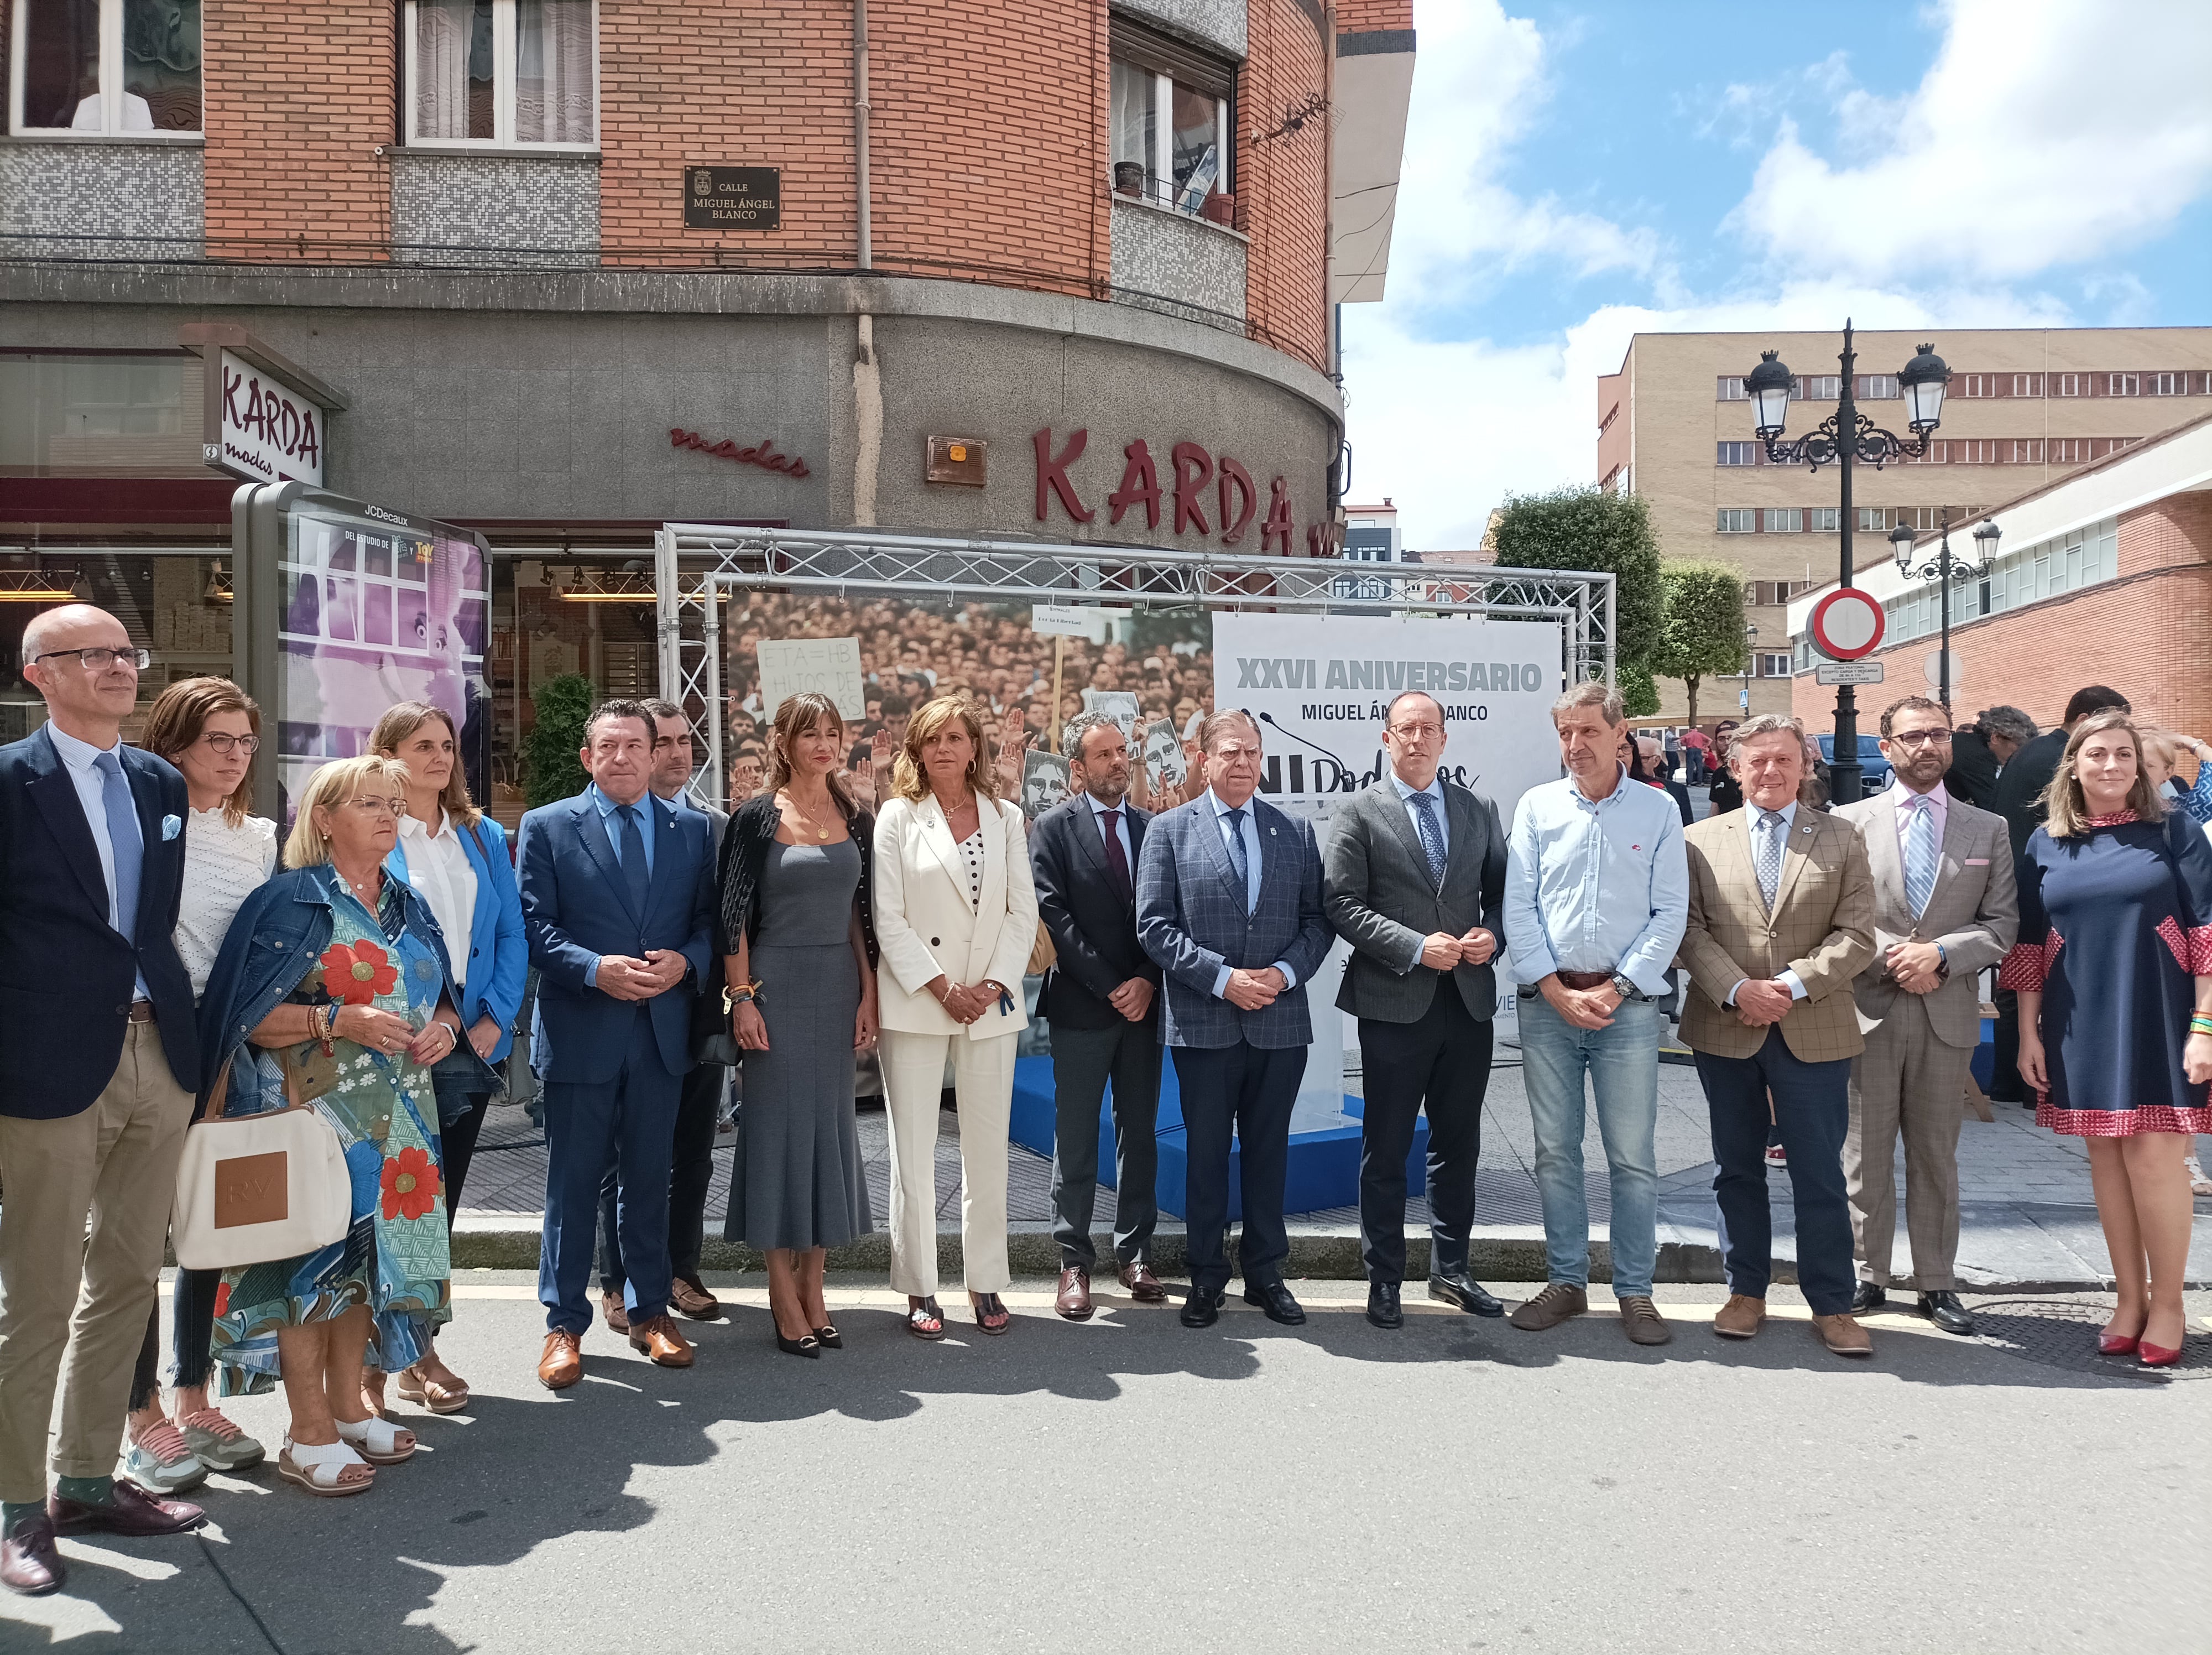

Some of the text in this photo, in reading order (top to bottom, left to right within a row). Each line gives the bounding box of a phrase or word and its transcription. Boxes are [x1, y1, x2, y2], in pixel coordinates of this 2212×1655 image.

[719, 183, 748, 192] CALLE
[693, 197, 775, 209] MIGUEL ÁNGEL
[712, 210, 757, 220] BLANCO
[223, 365, 319, 469] KARDA
[225, 442, 273, 476] modas
[670, 428, 811, 477] modas
[1033, 426, 1295, 557] KARDA
[364, 504, 408, 527] JCDecaux
[345, 530, 389, 549] DEL ESTUDIO DE
[415, 541, 435, 557] TOY
[409, 547, 414, 555] Y
[774, 671, 857, 693] HIJOS DE
[1237, 658, 1542, 692] XXVI ANIVERSARIO
[1302, 704, 1365, 720] MIGUEL
[223, 1176, 275, 1204] RV
